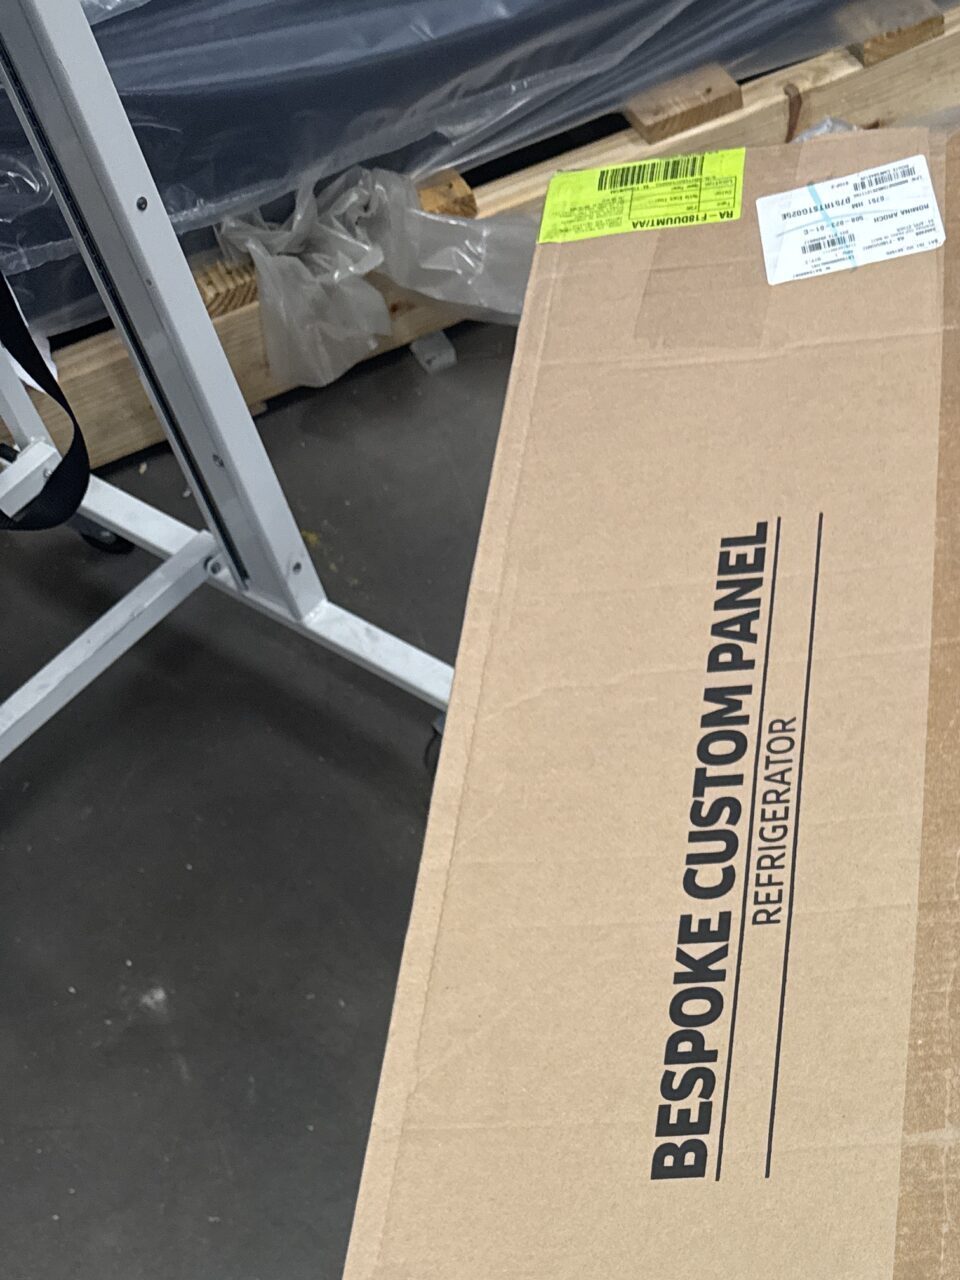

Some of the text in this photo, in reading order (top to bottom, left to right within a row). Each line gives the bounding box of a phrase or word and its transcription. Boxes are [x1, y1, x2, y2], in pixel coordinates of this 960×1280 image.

[651, 521, 768, 1180] BESPOKE CUSTOM PANEL
[752, 716, 796, 925] REFRIGERATOR
